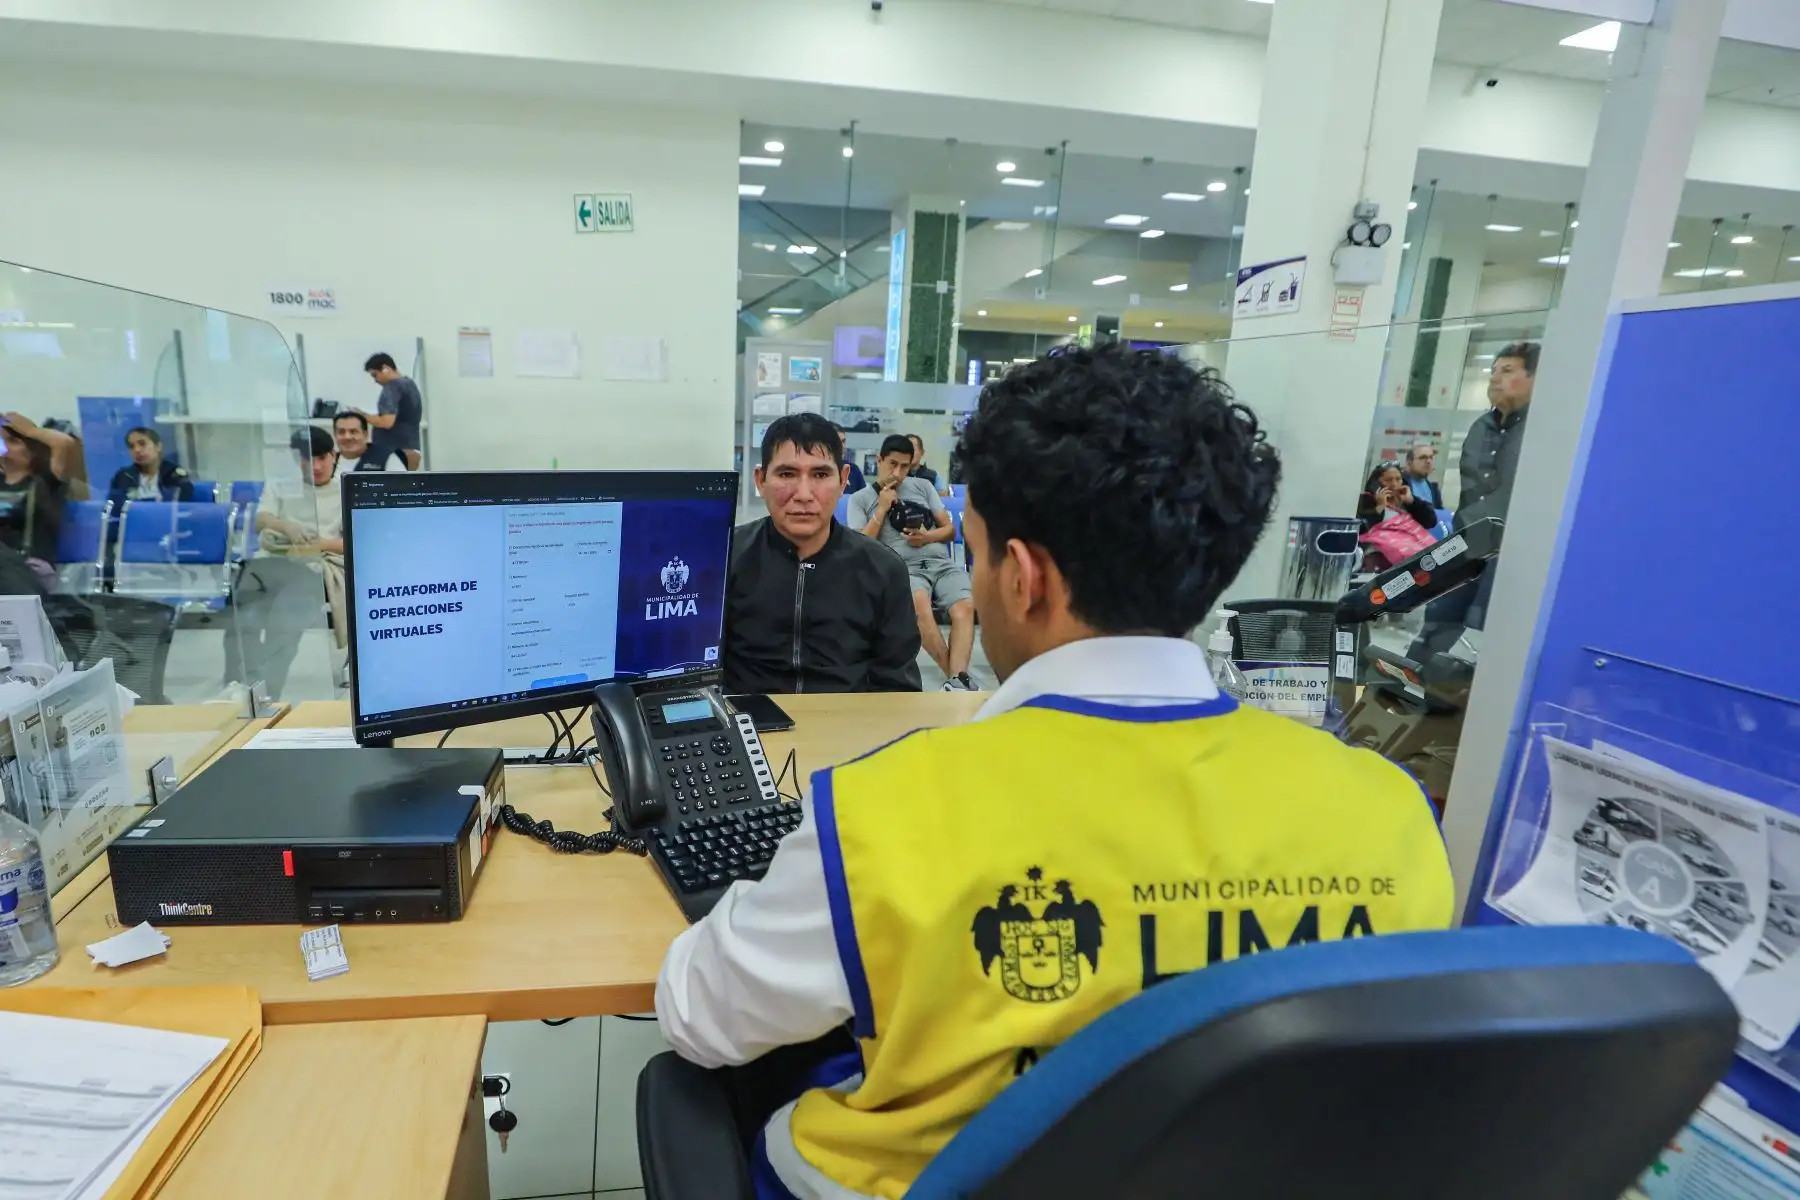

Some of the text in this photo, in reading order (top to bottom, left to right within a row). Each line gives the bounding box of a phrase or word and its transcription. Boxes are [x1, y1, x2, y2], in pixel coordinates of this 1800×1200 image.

[598, 200, 631, 225] SALIDA
[271, 292, 304, 304] 1800
[368, 580, 478, 599] PLATAFORMA DE
[369, 601, 463, 620] OPERACIONES
[645, 600, 698, 620] LIMA
[370, 623, 443, 641] VIRTUALES
[1252, 679, 1328, 688] DE TRABAJO Y
[1277, 692, 1297, 700] DEL
[363, 730, 392, 739] Lenovo
[1132, 876, 1396, 902] MUNICIPALIDAD DE
[159, 902, 213, 916] ThinkCentre
